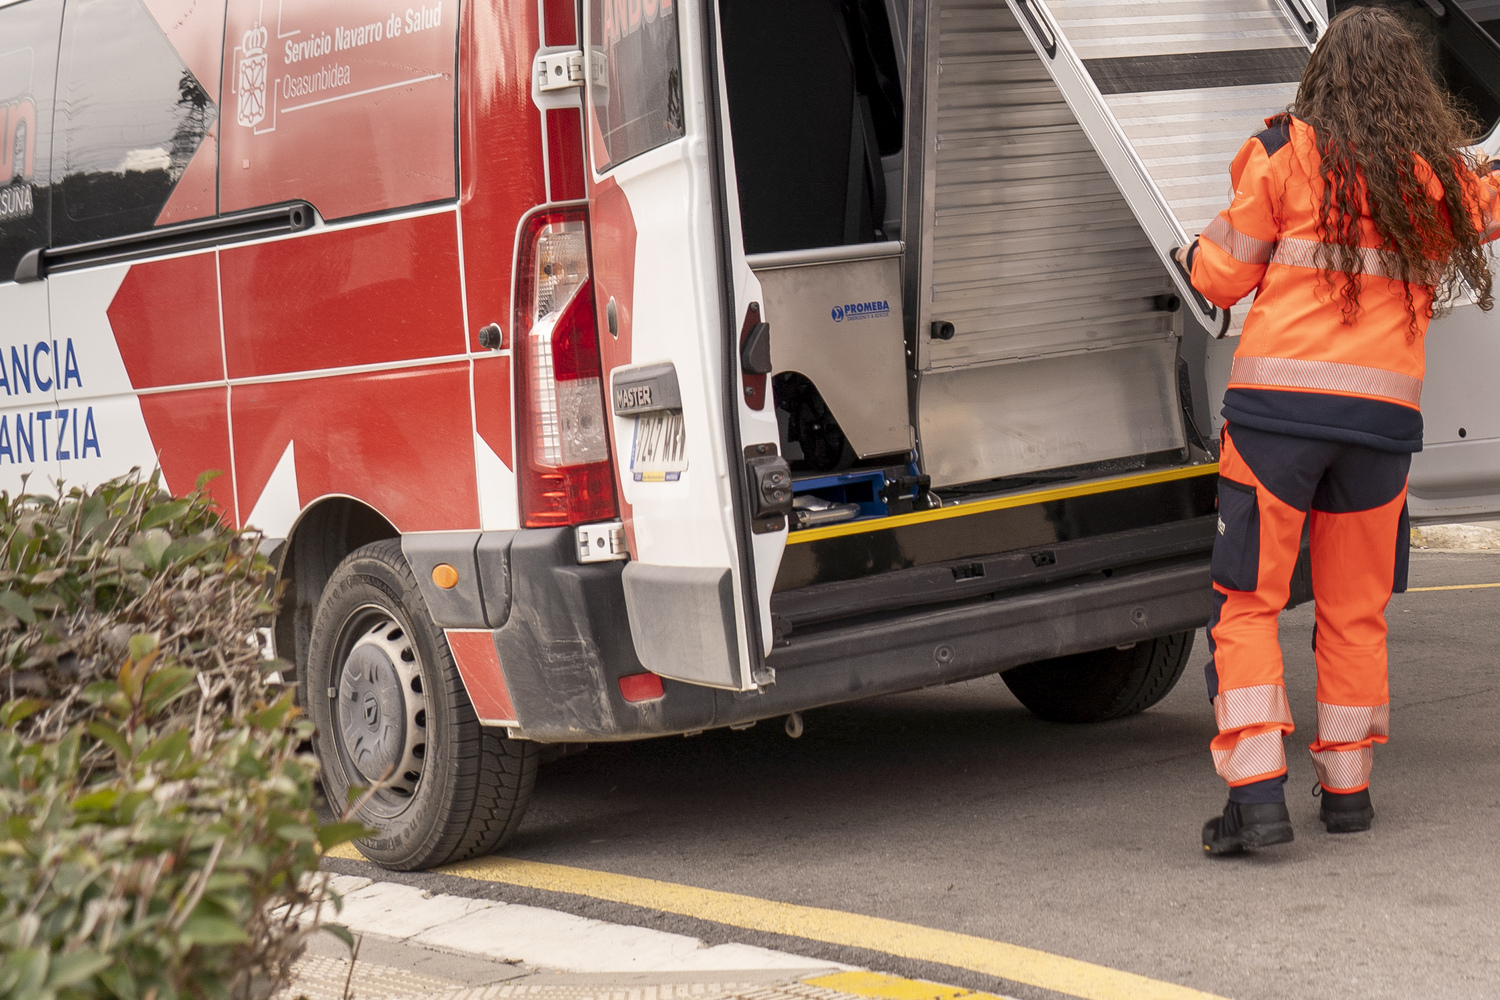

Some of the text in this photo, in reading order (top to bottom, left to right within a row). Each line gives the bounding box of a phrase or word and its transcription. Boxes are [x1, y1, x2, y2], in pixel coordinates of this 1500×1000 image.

[284, 1, 442, 65] Servicio Navarro de Salud
[283, 64, 350, 99] Osasunbidea
[844, 300, 889, 314] PROMEBA
[616, 385, 653, 408] MASTER
[0, 406, 101, 465] ANTZIA
